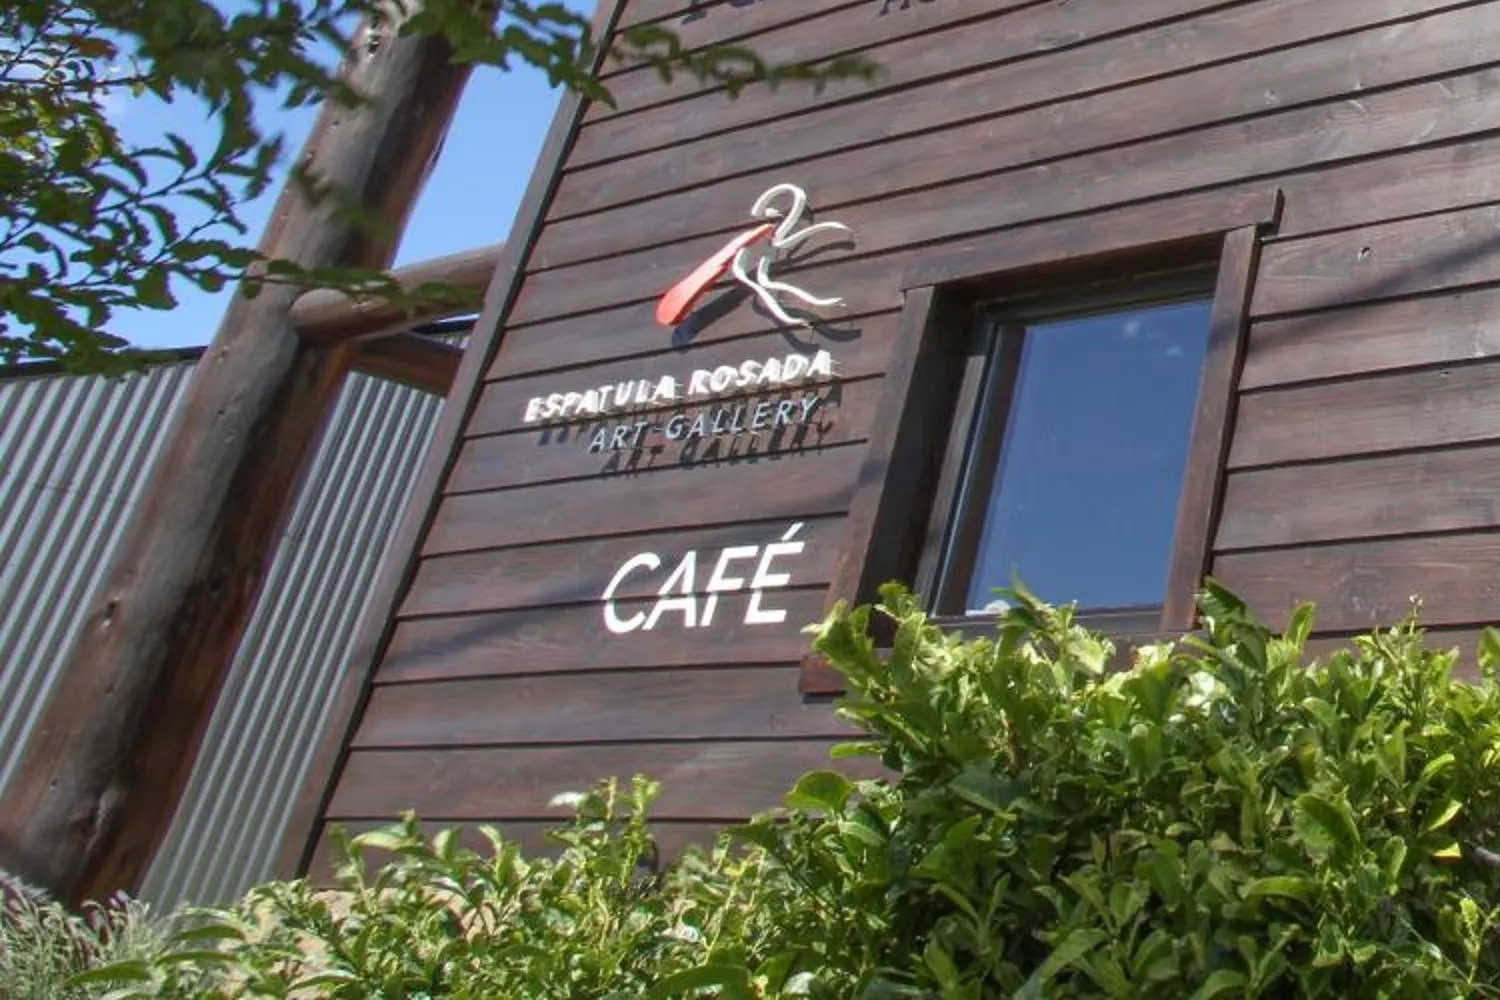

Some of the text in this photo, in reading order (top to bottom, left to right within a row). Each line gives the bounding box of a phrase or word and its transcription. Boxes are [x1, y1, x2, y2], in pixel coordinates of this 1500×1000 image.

[523, 349, 836, 423] ESPATULA ROSADA
[589, 397, 822, 454] ART GALLERY
[601, 521, 805, 634] CAFÉ
